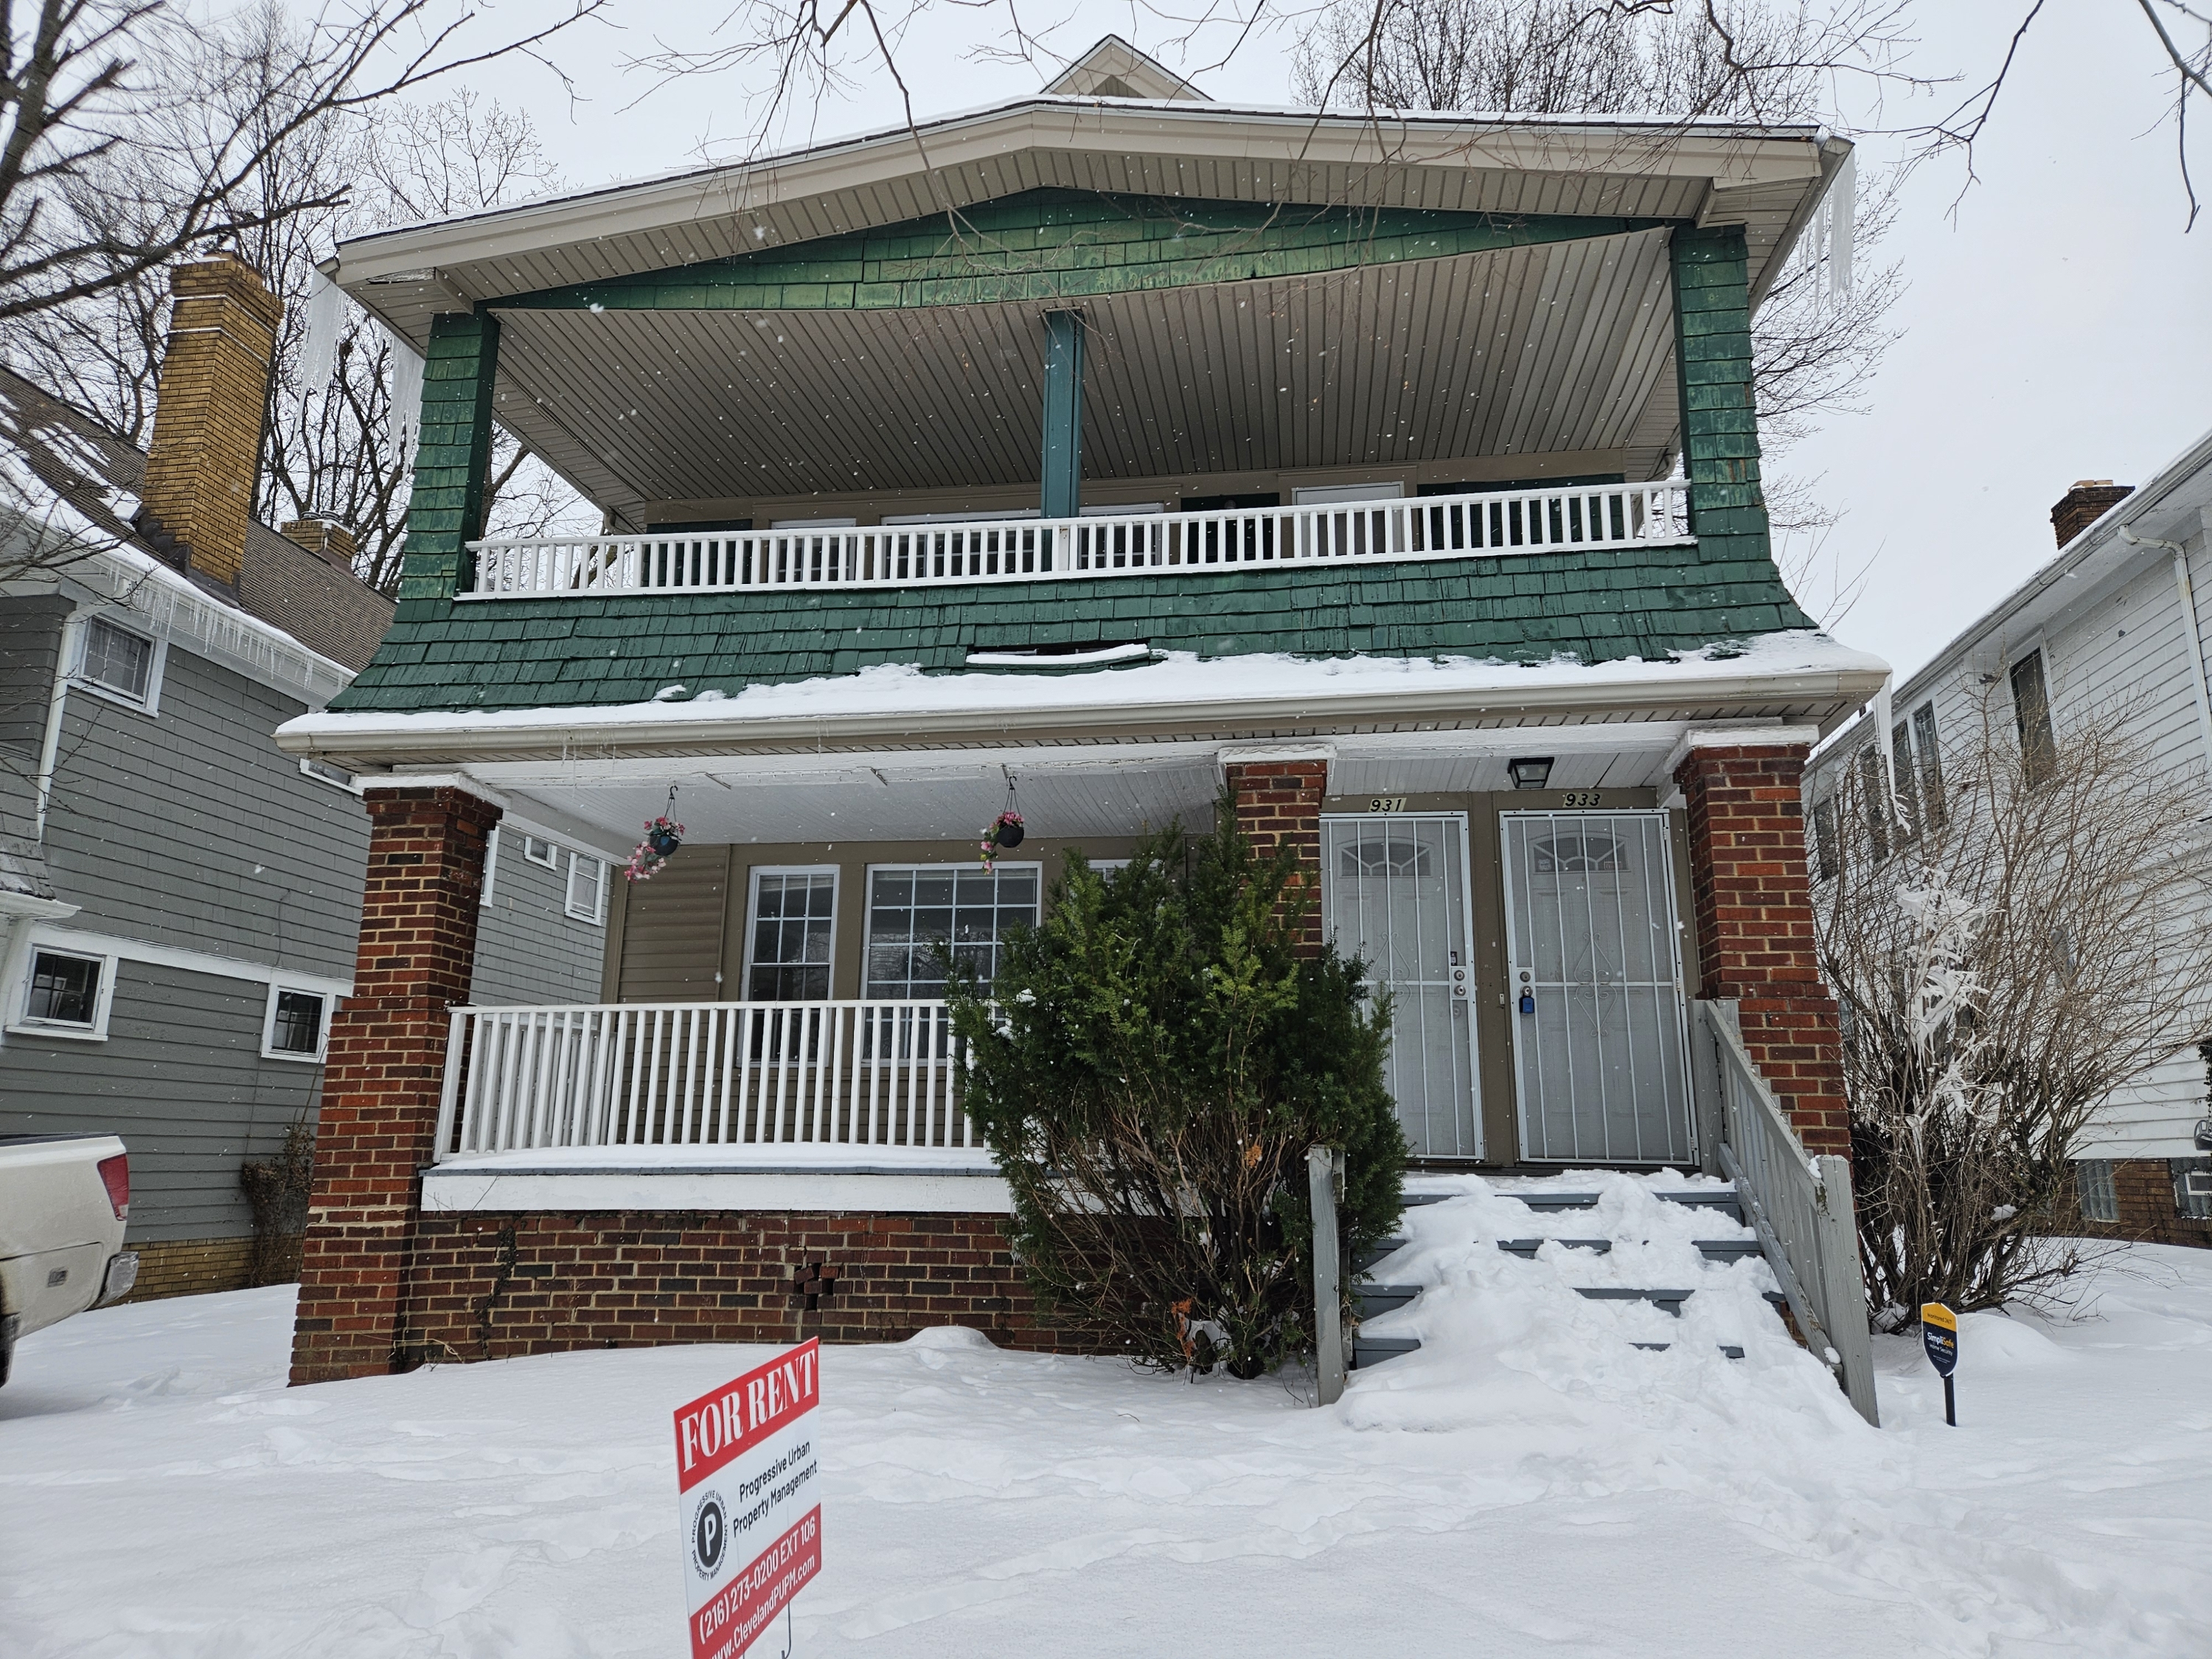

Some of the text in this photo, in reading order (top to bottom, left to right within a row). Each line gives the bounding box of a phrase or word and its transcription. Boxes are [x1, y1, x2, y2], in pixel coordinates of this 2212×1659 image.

[1370, 799, 1402, 812] 931
[1565, 793, 1601, 807] 933
[1927, 1332, 1954, 1349] SimpliSafe
[1929, 1343, 1952, 1357] Home Security
[680, 1349, 815, 1472] FOR RENT
[733, 1459, 818, 1538] Property Management
[740, 1441, 810, 1503] Progressive Urban
[692, 1490, 727, 1543] PROGRESSIVE URBAN
[704, 1513, 717, 1557] P
[692, 1523, 728, 1581] PROPERTY MANAGEMENT
[700, 1515, 815, 1645] (216) 273-0200 EXT 106
[709, 1554, 815, 1659] ww.ClevelandPUPM.com
